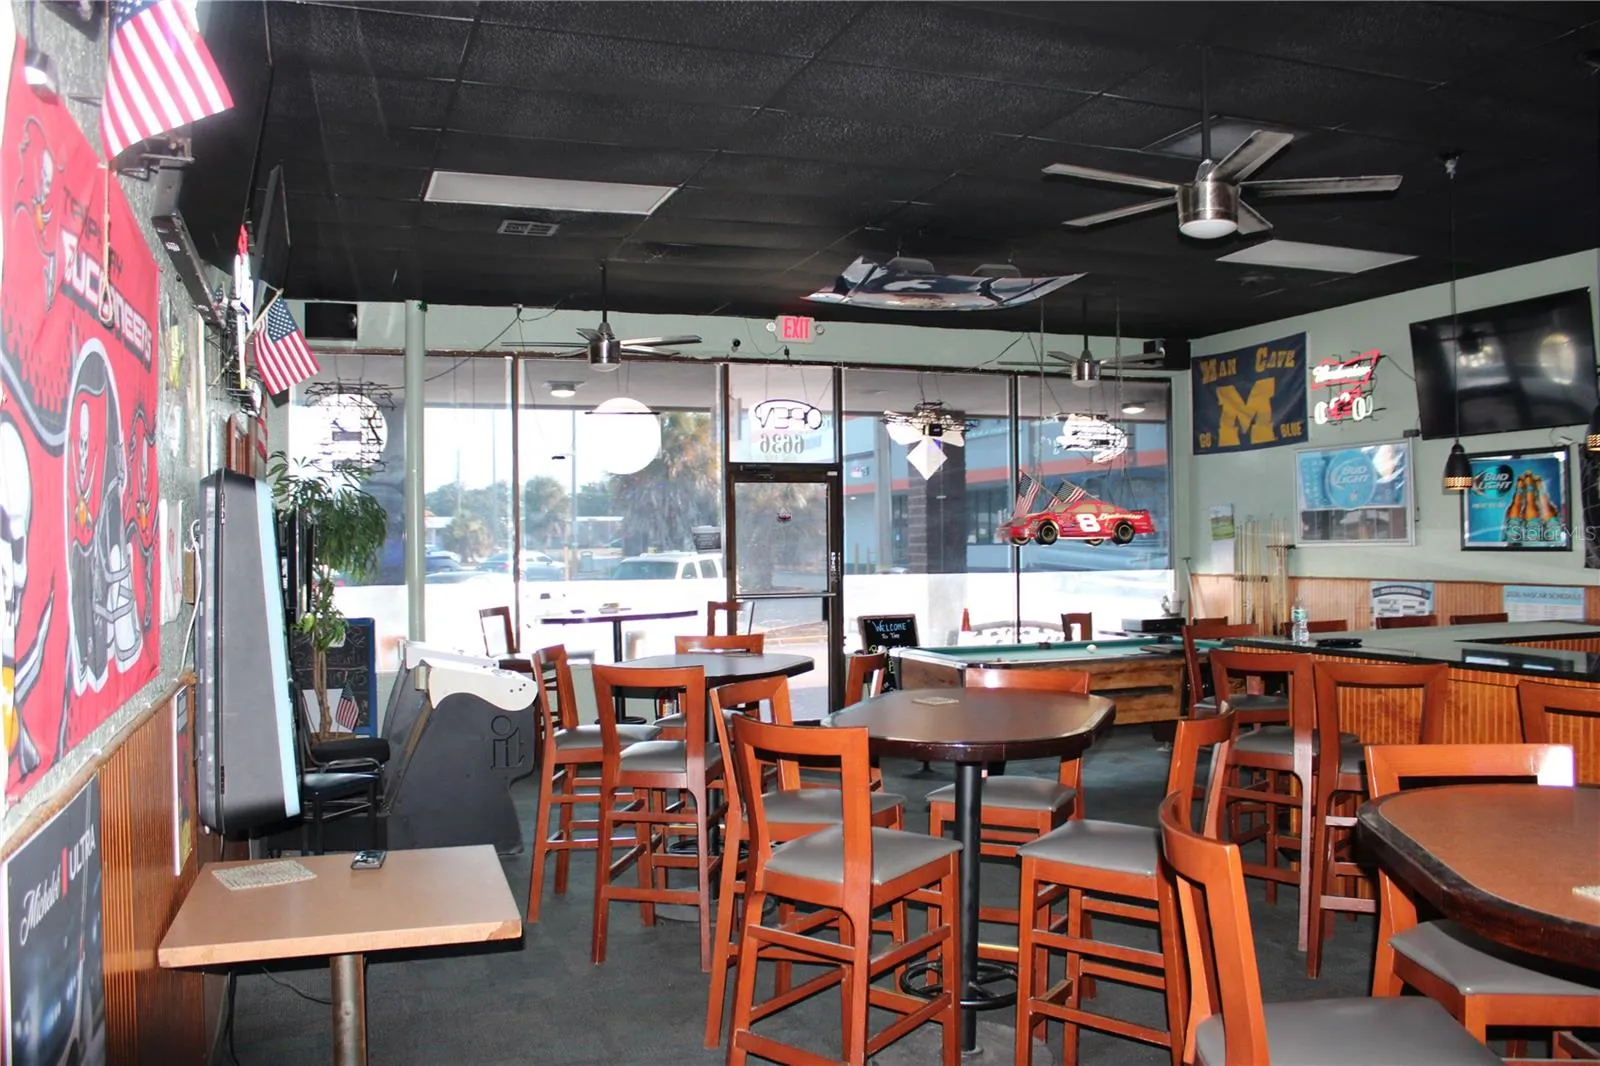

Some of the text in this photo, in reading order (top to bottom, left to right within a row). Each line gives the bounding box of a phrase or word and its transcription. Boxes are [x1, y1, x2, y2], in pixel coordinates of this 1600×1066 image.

[783, 317, 811, 339] EXIT
[1201, 347, 1296, 384] MAN CAVE
[1215, 377, 1279, 447] M
[1280, 422, 1304, 437] BLUE
[1200, 432, 1212, 448] GO
[1342, 464, 1368, 475] BUD
[1482, 472, 1510, 482] BUD
[1336, 474, 1369, 485] LIGHT
[1478, 481, 1513, 490] LIGHT
[1077, 513, 1101, 533] 8
[871, 620, 907, 633] WELCOME
[68, 823, 97, 881] ULTRA
[20, 863, 61, 946] Michelob
